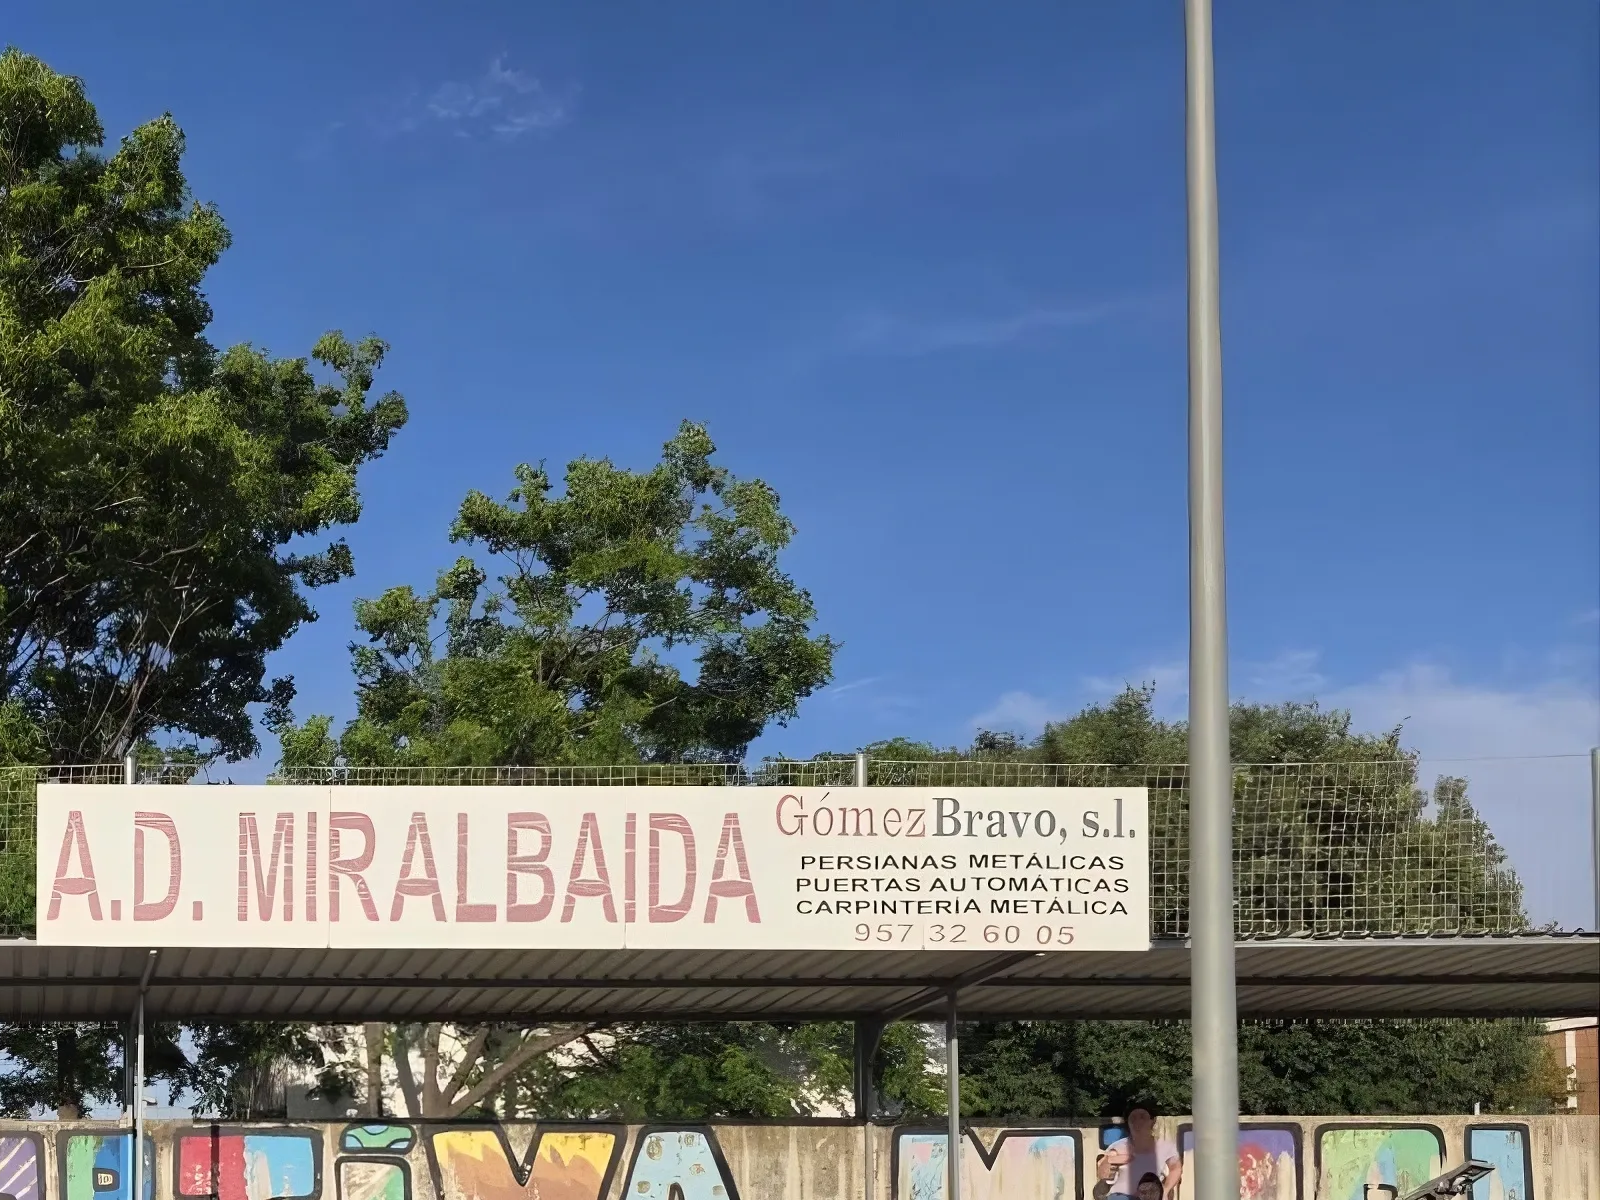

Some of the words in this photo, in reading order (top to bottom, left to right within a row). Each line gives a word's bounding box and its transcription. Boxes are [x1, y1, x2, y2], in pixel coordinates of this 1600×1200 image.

[1082, 798, 1136, 839] s.l.
[47, 810, 203, 921] A.D.
[238, 811, 761, 924] MIRALBAIDA
[801, 855, 957, 870] PERSIANAS
[969, 852, 1124, 870] METÁLICAS
[796, 878, 921, 892] PUERTAS
[929, 874, 1129, 895] AUTOMÁTICAS
[796, 896, 981, 915] CARPINTERÍA
[990, 896, 1128, 916] METÁLICA
[854, 923, 914, 943] 957
[929, 924, 967, 943] 32
[983, 924, 1020, 944] 60
[1036, 925, 1074, 945] 05
